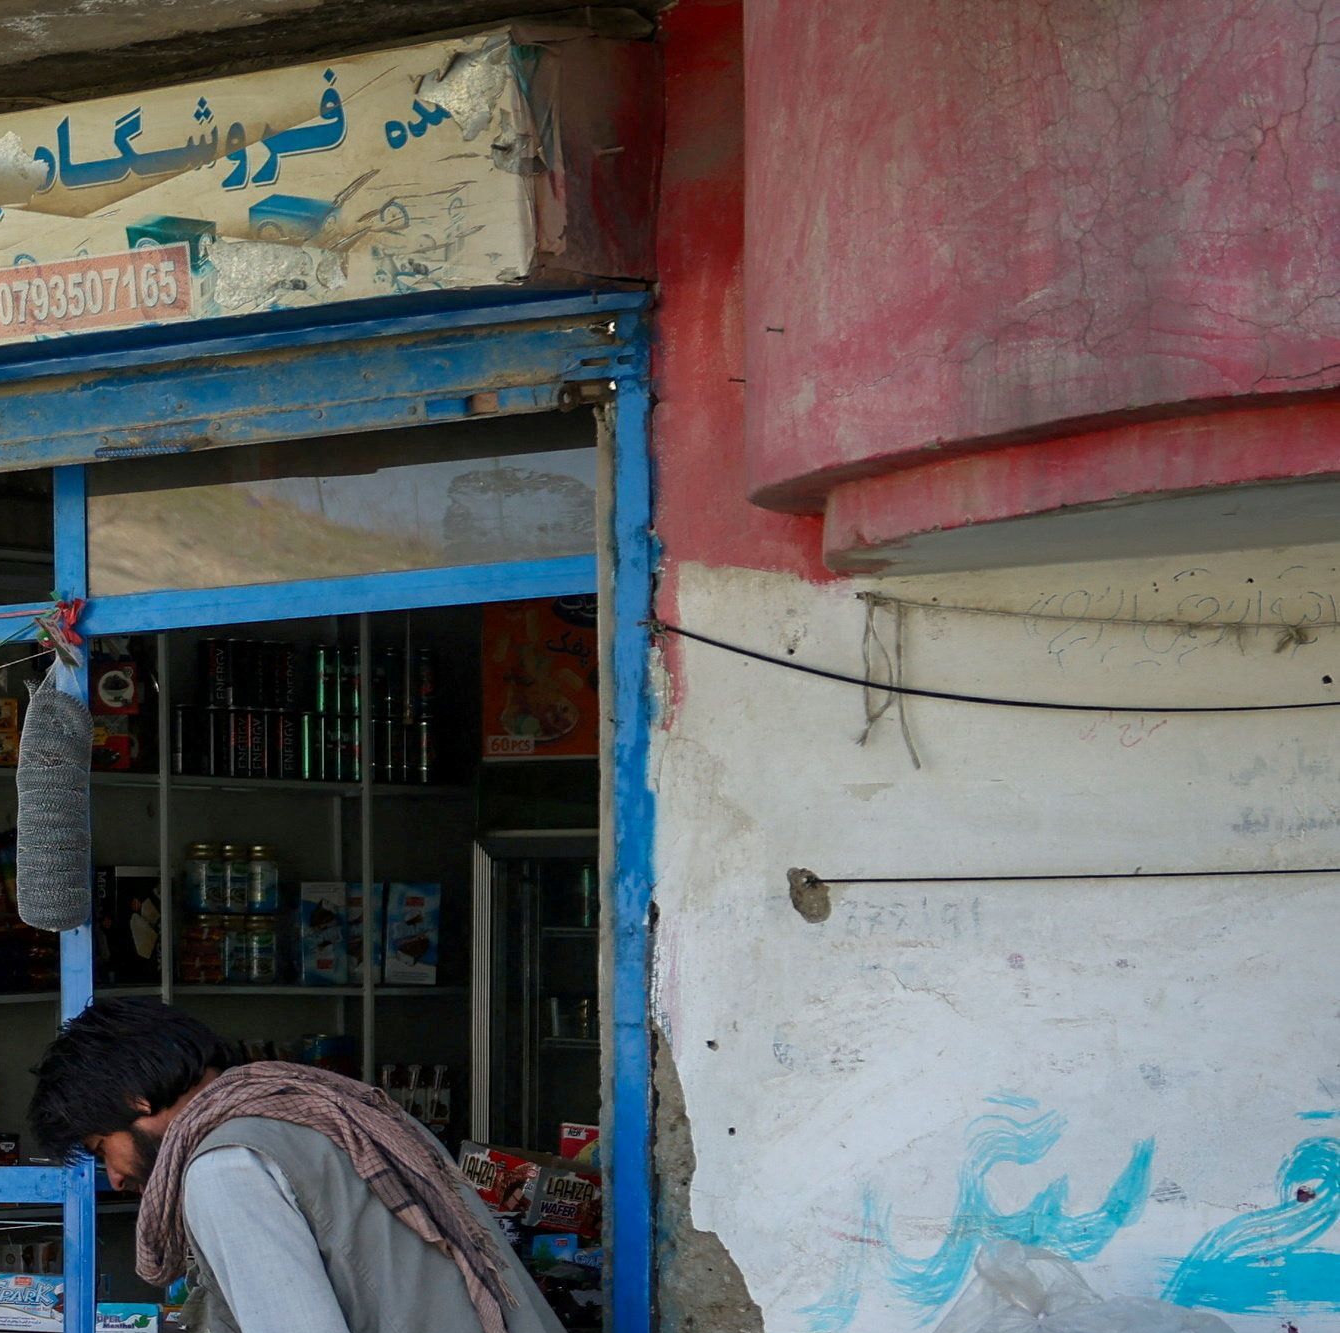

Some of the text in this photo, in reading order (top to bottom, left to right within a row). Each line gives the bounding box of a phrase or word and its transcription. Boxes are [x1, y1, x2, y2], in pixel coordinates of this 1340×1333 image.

[461, 1154, 497, 1190] LAHZA
[546, 1177, 595, 1202] LAHZA
[540, 1201, 577, 1218] WAFER
